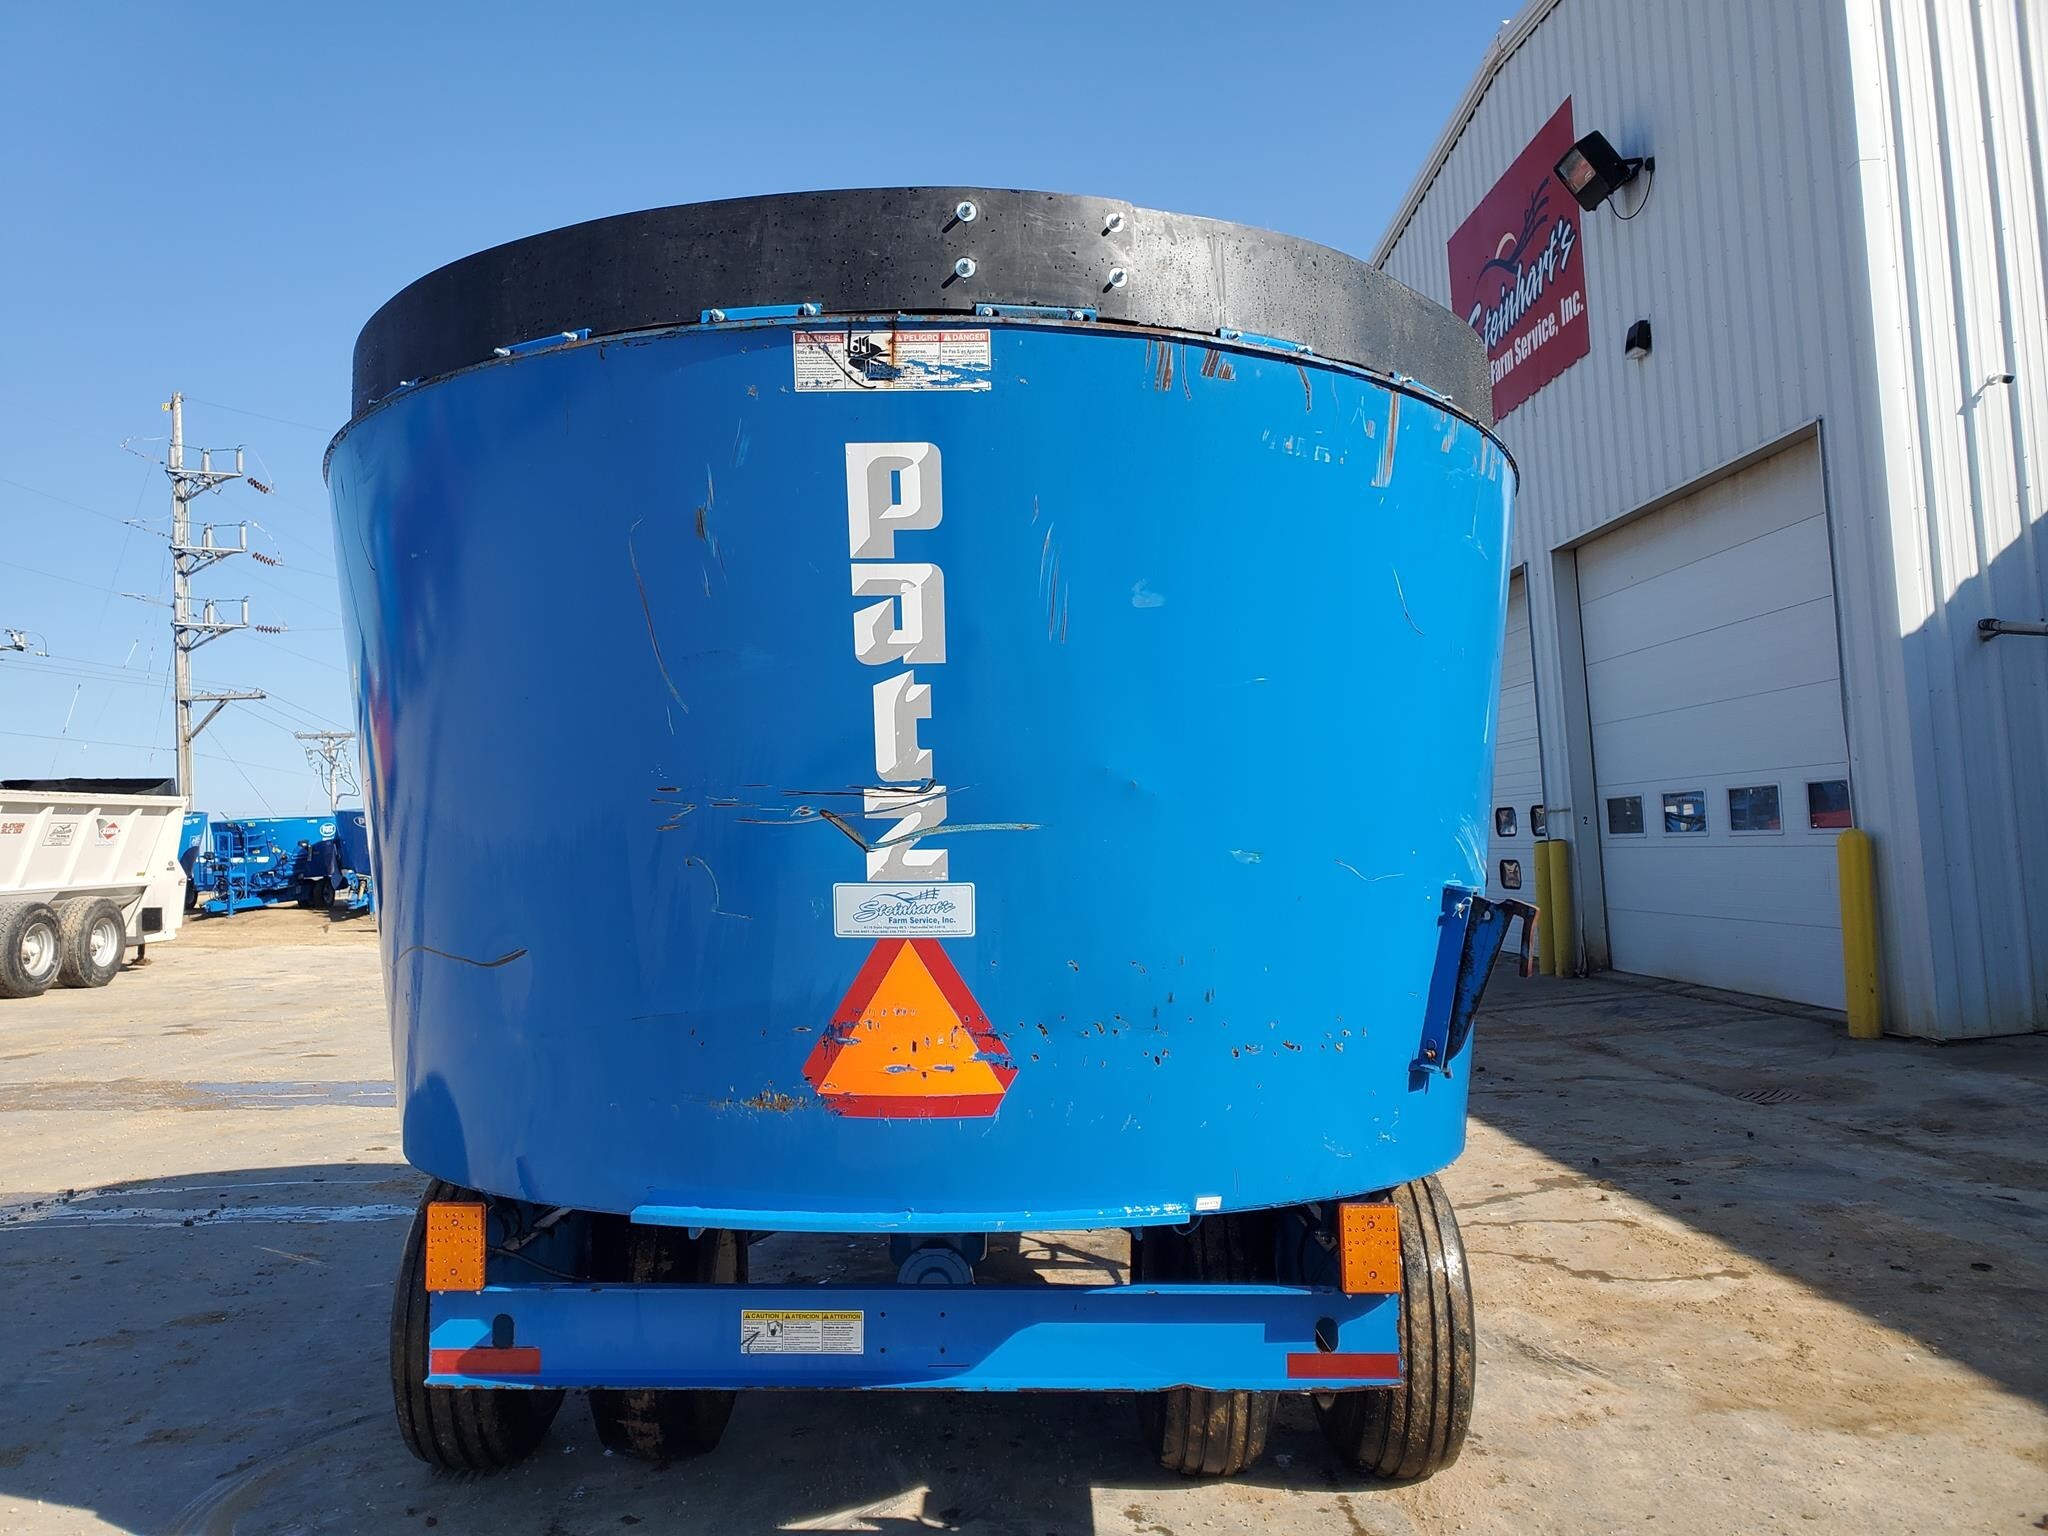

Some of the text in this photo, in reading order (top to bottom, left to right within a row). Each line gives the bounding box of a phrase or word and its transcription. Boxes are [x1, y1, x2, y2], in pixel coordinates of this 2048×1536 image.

[903, 334, 938, 342] PELIGRO
[952, 333, 986, 341] DANGER
[1490, 290, 1584, 385] Farm Service, Inc.
[1583, 815, 1588, 825] 2
[853, 900, 956, 923] Steinhart's
[909, 917, 940, 925] Service,
[942, 916, 957, 924] Inc.
